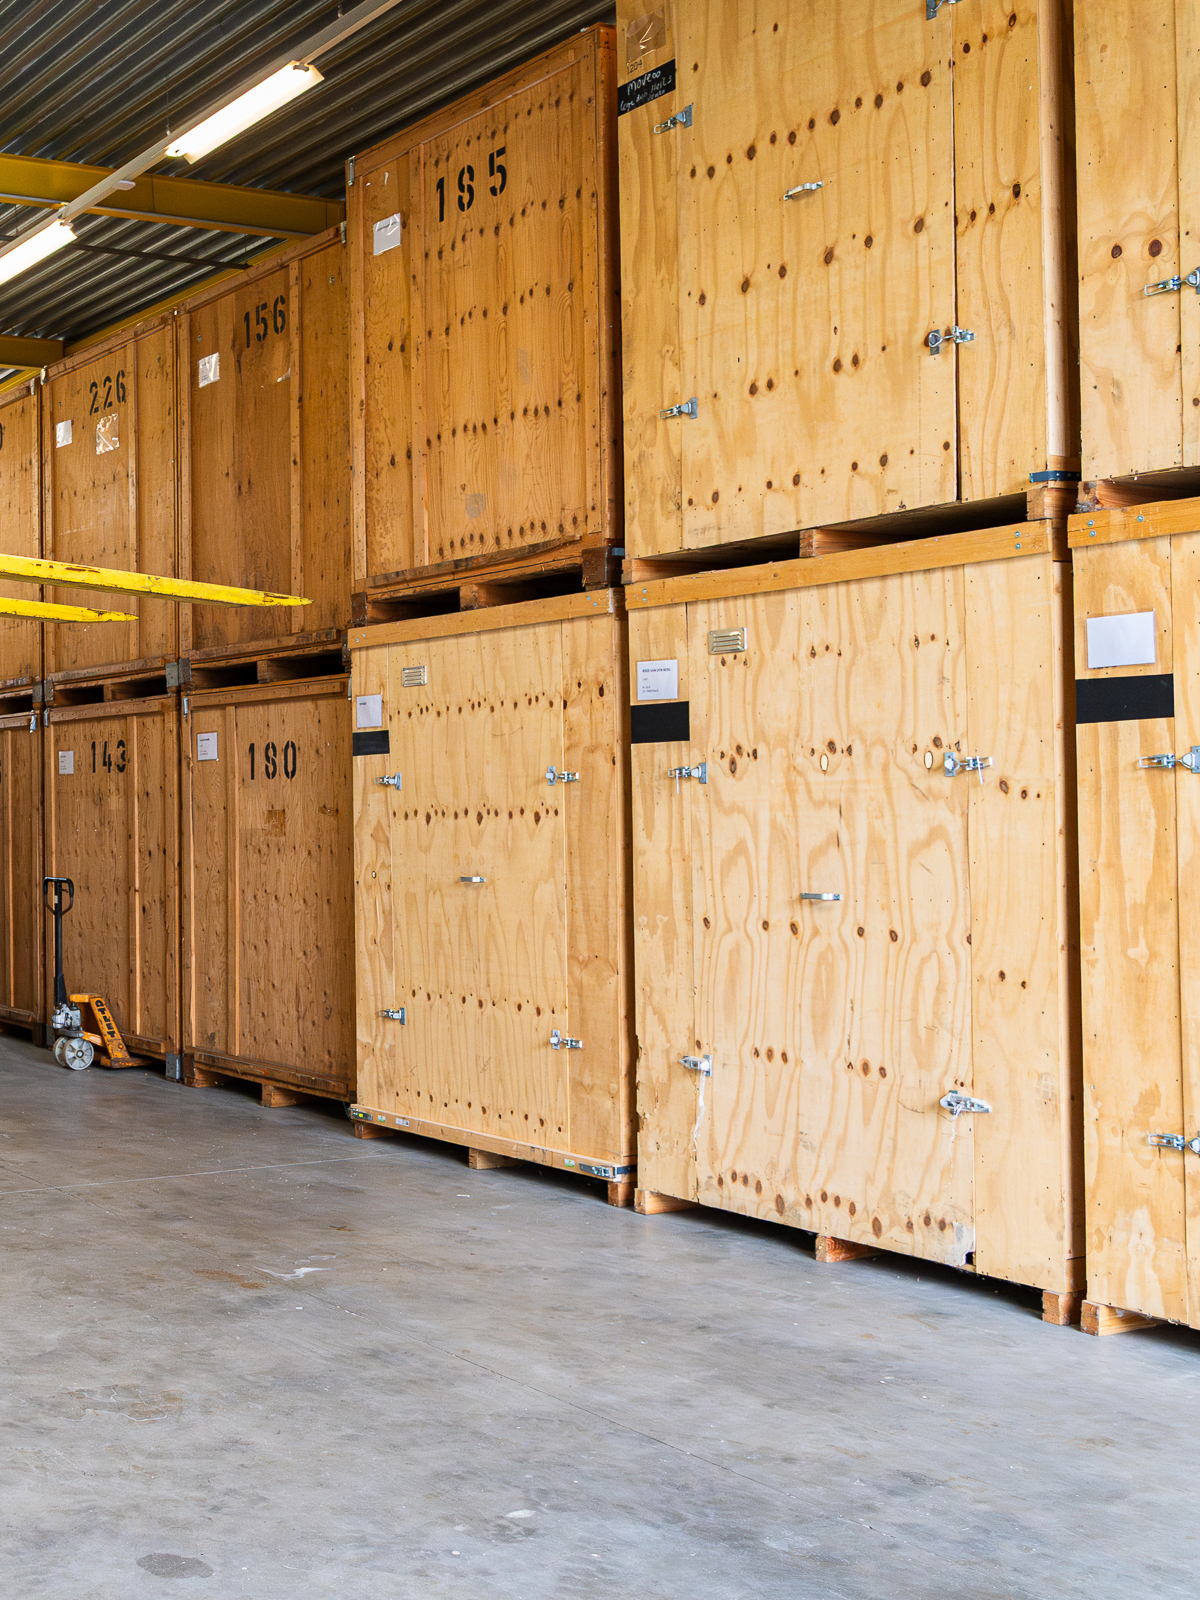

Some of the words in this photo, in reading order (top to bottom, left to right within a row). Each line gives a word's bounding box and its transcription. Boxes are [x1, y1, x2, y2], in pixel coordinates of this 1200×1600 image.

[244, 295, 286, 349] 156
[89, 369, 126, 416] 226
[91, 739, 127, 773] 143
[249, 740, 297, 781] 180
